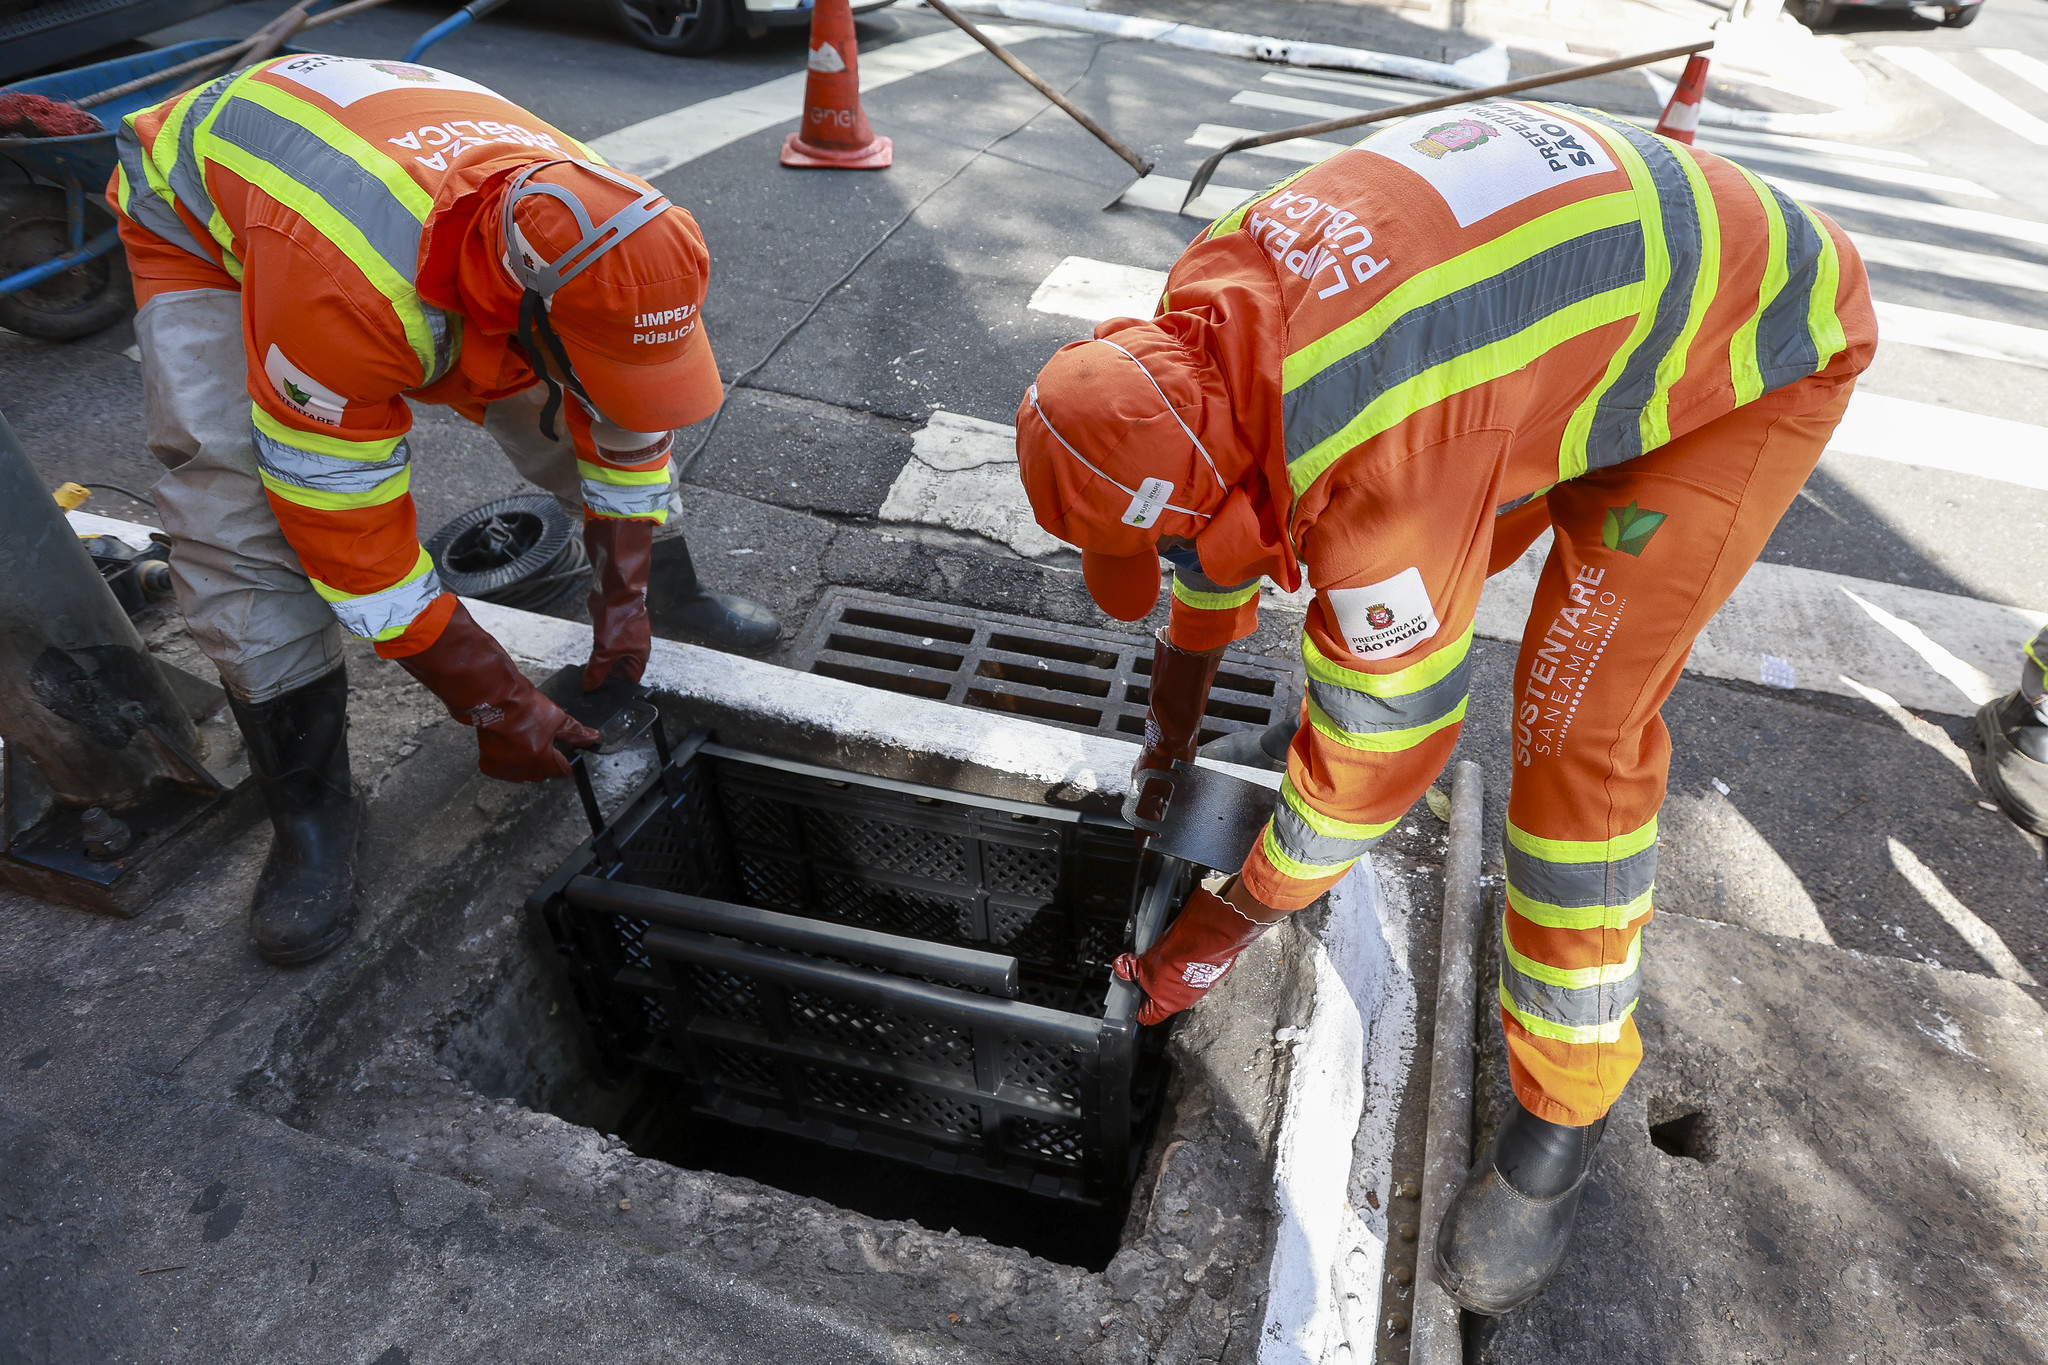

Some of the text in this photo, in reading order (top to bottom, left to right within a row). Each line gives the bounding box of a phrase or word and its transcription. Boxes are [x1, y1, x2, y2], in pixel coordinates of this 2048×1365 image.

[811, 106, 857, 128] enel
[1540, 123, 1595, 167] SÃO
[1269, 190, 1391, 284] PÚBLICA
[1250, 212, 1350, 301] LIMPEZA
[633, 302, 697, 328] LIMPEZA
[633, 320, 695, 345] PÚBLICA
[1139, 481, 1162, 515] SUSTNTARE
[1352, 613, 1425, 644] PREFEITURA DE
[1355, 620, 1428, 654] SÃO PAULO
[1515, 564, 1607, 768] SUSTENTARE
[1535, 591, 1617, 756] SANEAMENTO
